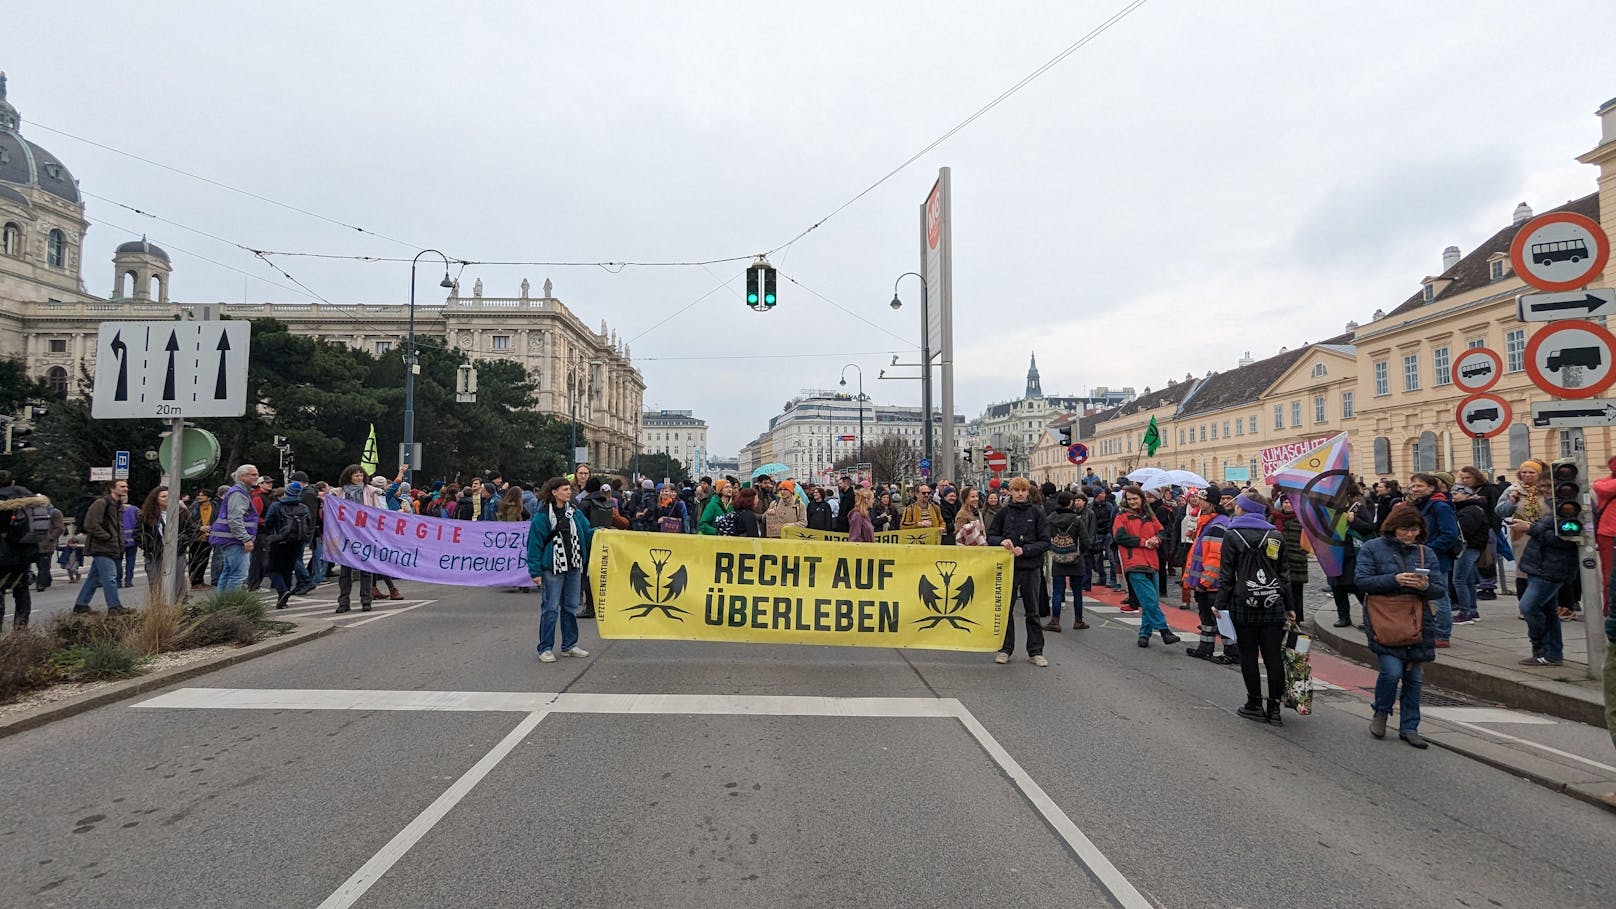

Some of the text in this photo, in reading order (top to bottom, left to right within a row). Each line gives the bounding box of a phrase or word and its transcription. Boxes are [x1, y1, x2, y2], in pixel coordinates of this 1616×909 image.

[156, 404, 182, 415] 20m
[337, 505, 528, 549] ENERGIE sozi
[342, 537, 528, 572] regional erneuerb
[714, 552, 896, 590] RECHT AUF
[704, 587, 900, 633] ÜBERLEBEN
[993, 613, 1001, 636] LETZTE
